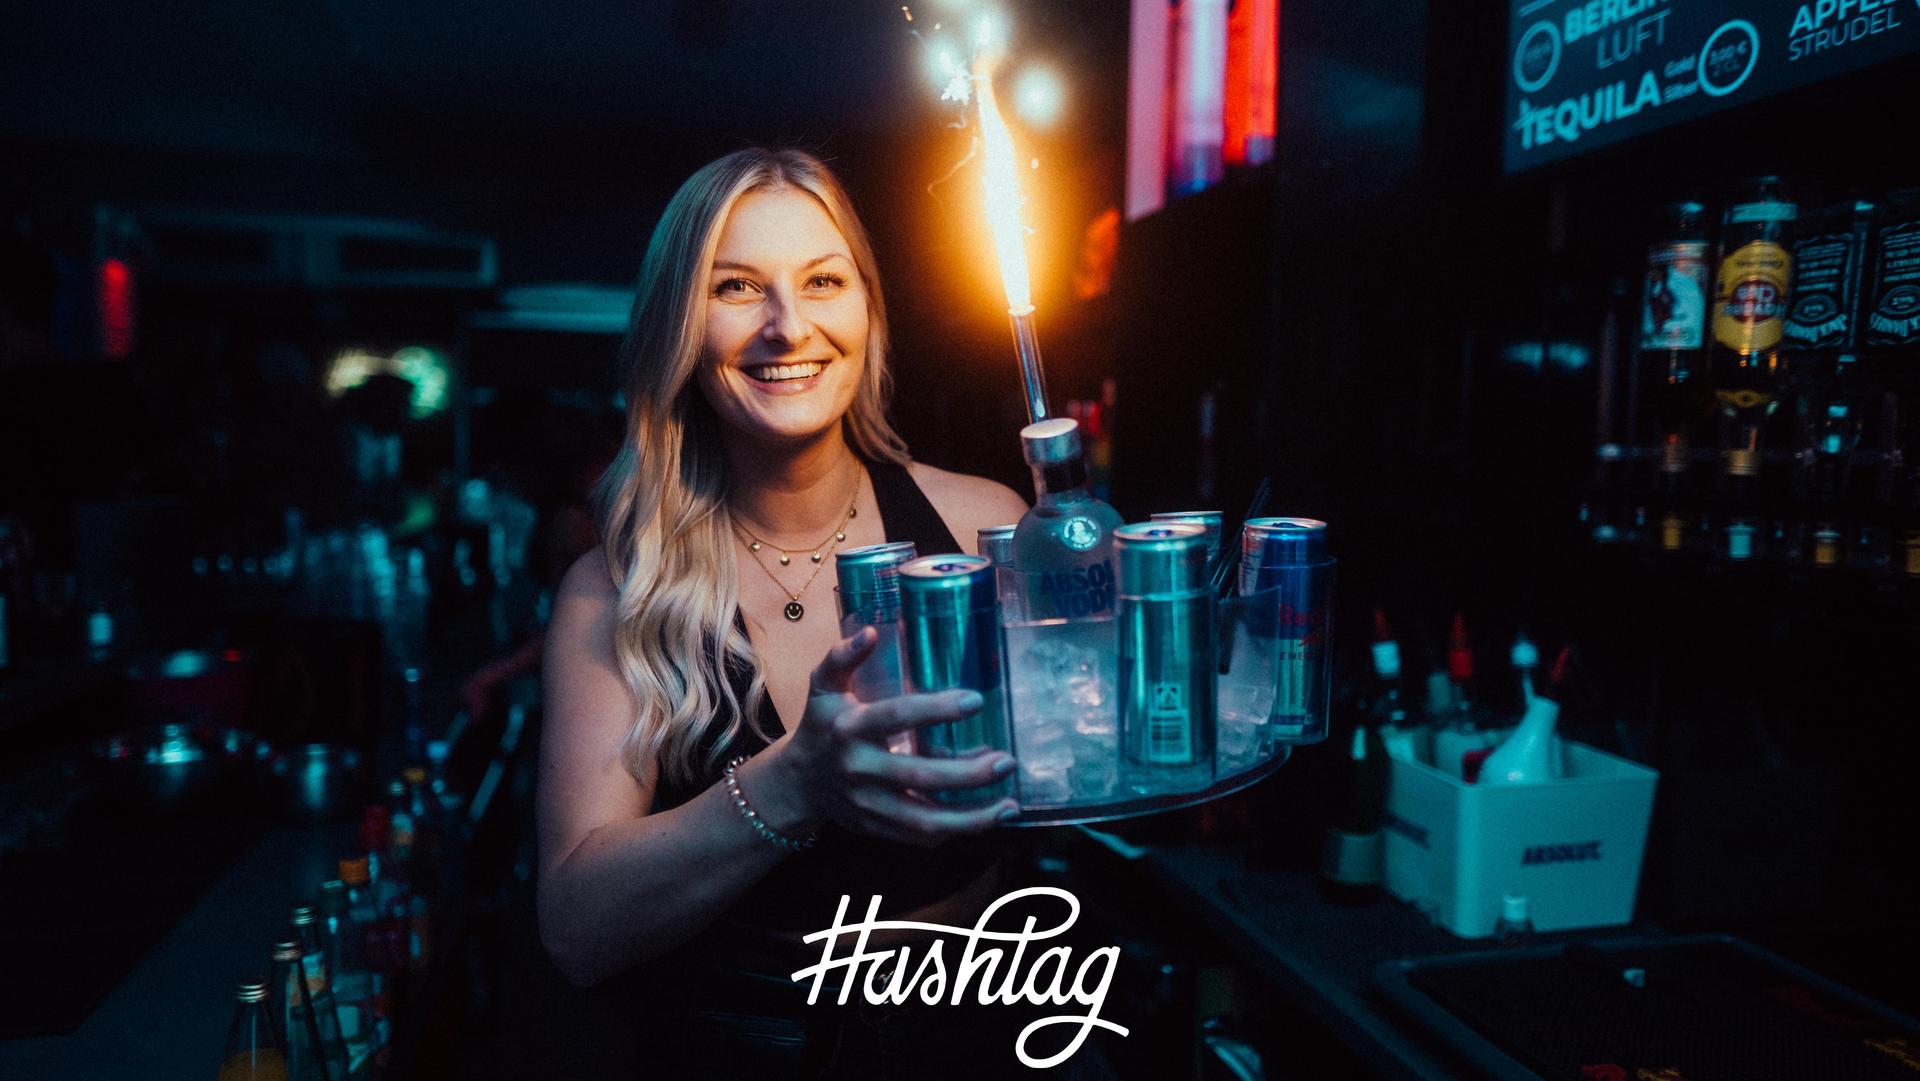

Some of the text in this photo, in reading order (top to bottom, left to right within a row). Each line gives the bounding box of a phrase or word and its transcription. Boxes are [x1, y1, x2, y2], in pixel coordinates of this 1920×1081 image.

[1597, 8, 1672, 69] LUFT
[1788, 7, 1901, 61] STRUDEL
[1514, 69, 1662, 150] TEQUILA
